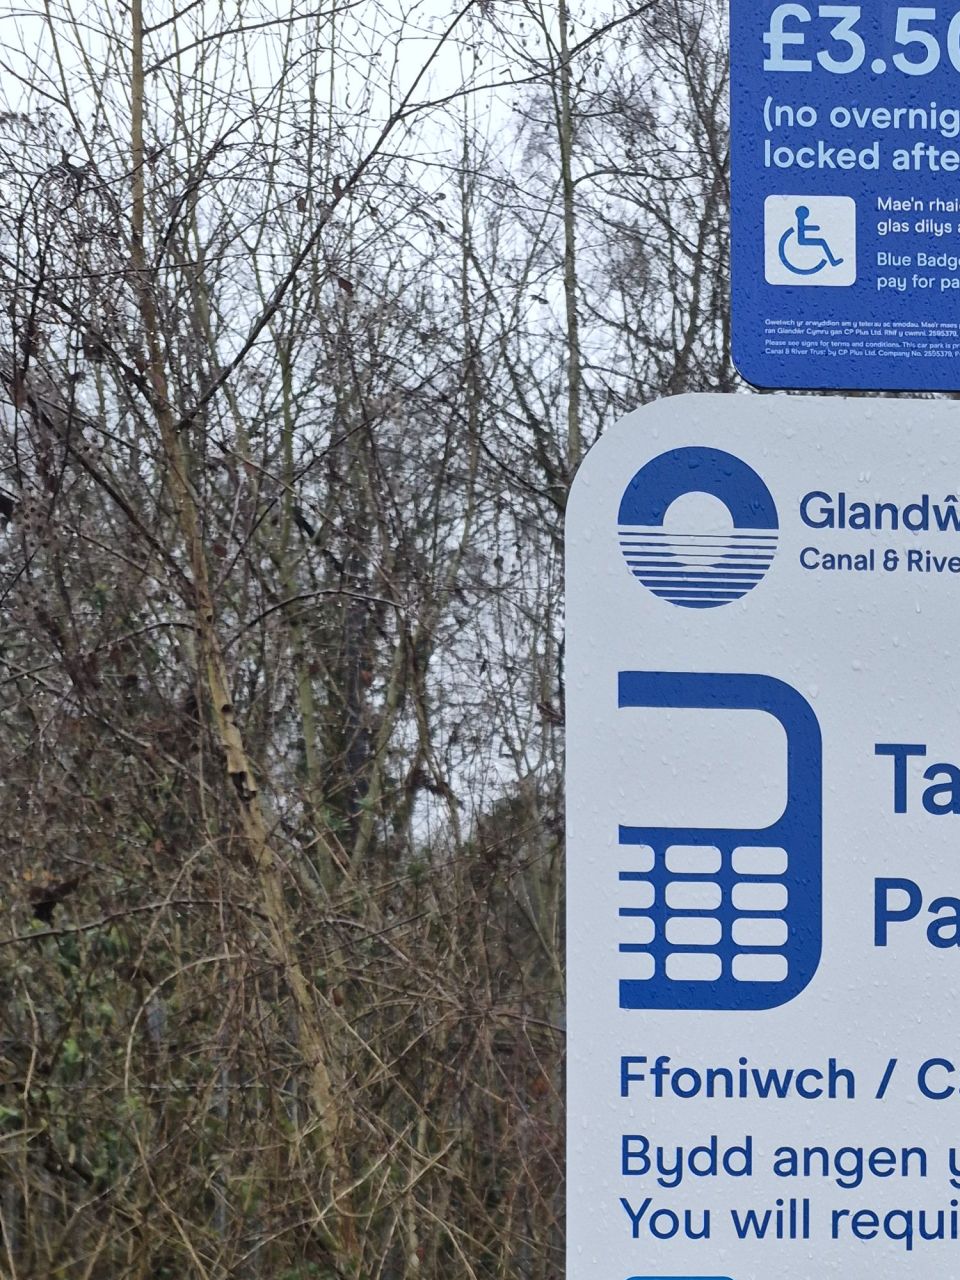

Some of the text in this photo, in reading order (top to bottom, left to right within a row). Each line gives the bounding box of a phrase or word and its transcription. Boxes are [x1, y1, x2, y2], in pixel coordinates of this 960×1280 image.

[764, 96, 817, 131] (no
[765, 140, 879, 169] locked
[878, 197, 923, 210] Mae'n
[878, 219, 909, 235] glas
[915, 219, 951, 236] dilys
[878, 252, 911, 266] Blue
[878, 277, 906, 291] pay
[912, 274, 935, 288] for
[800, 547, 874, 570] Canal
[883, 549, 899, 571] &
[621, 1056, 854, 1099] Ffoniwch
[876, 1059, 897, 1099] /
[622, 1135, 752, 1188] Bydd
[774, 1147, 926, 1188] angen
[620, 1198, 710, 1239] You
[731, 1199, 809, 1238] will
